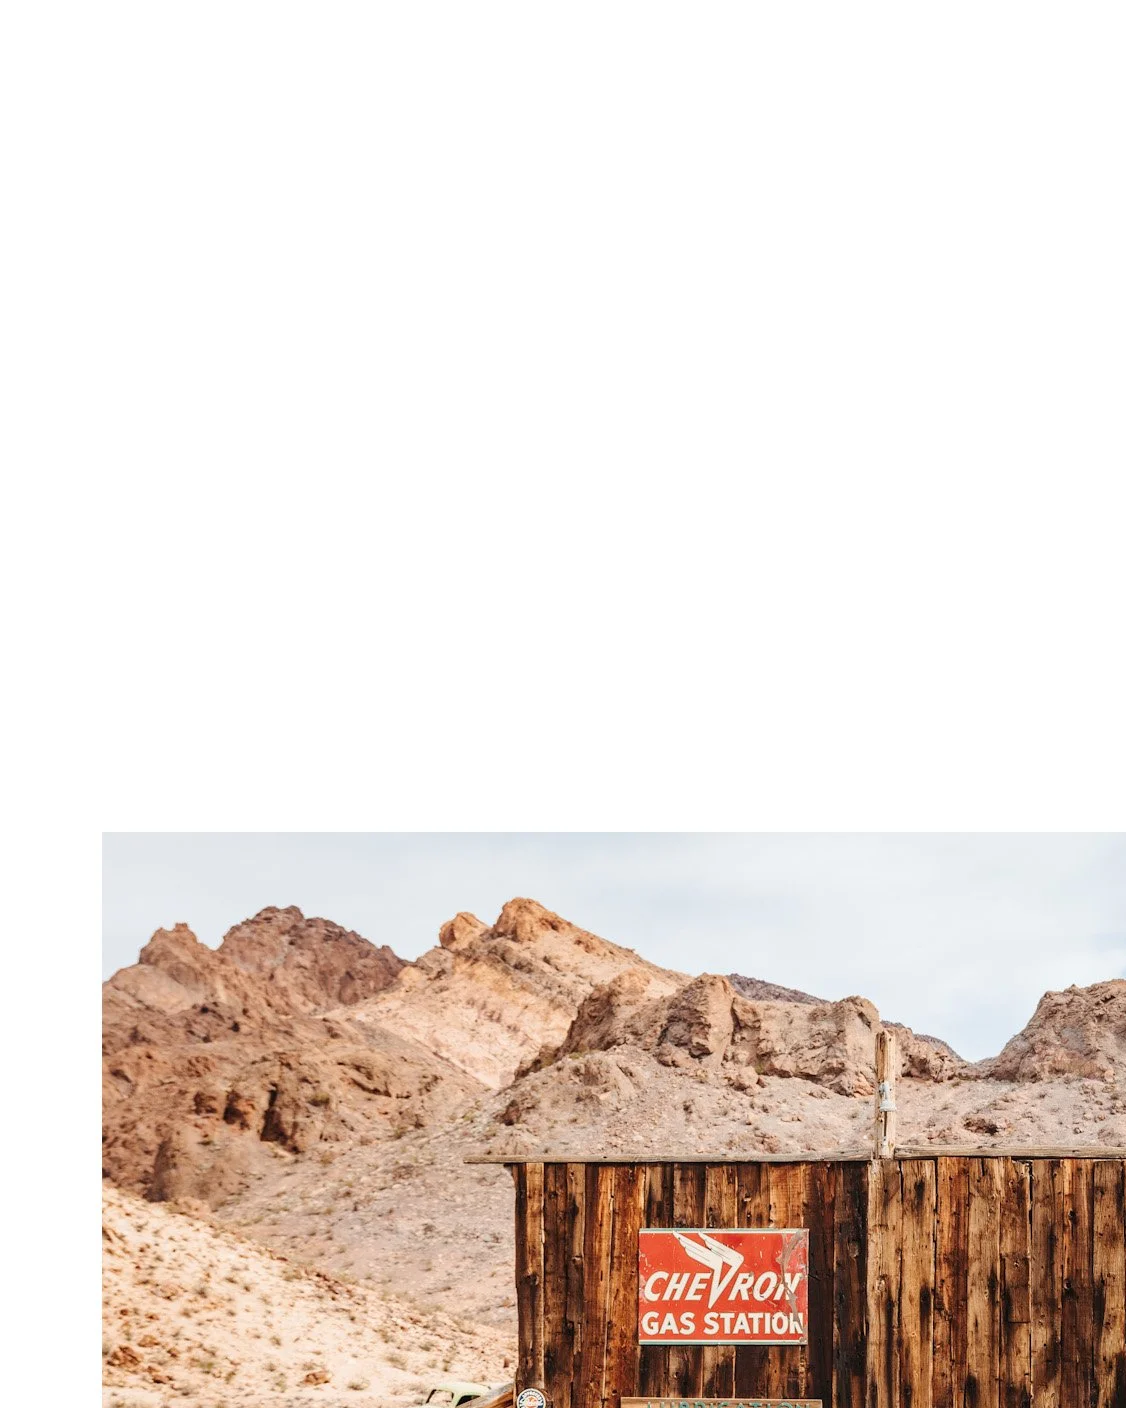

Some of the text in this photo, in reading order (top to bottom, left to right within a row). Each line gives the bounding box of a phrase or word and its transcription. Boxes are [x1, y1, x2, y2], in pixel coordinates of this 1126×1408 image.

[643, 1270, 802, 1309] CHEVRON
[641, 1312, 803, 1335] GAS STATION
